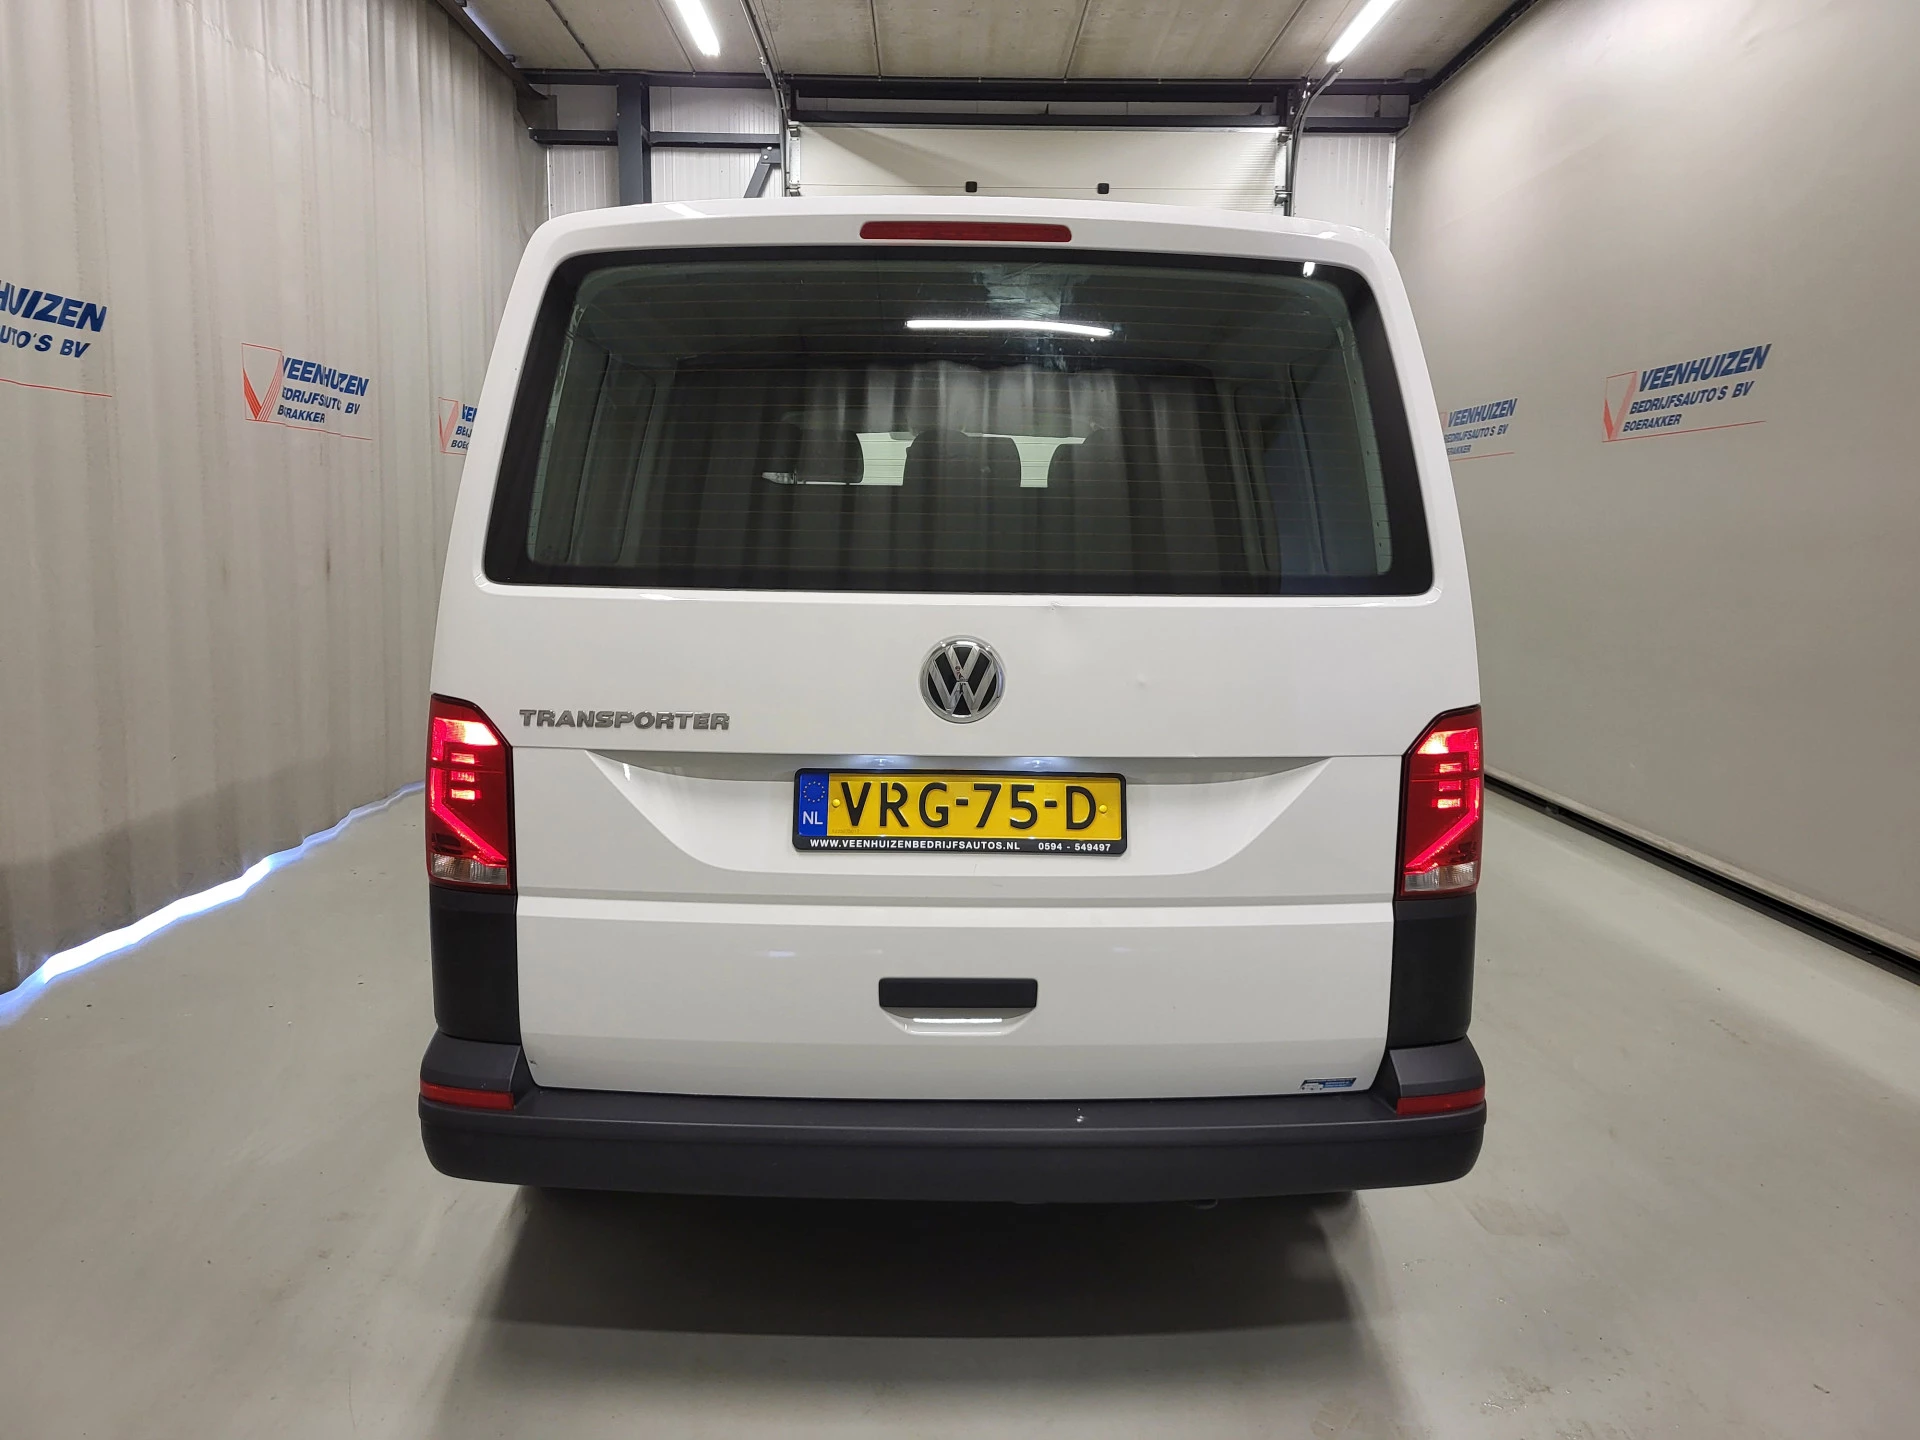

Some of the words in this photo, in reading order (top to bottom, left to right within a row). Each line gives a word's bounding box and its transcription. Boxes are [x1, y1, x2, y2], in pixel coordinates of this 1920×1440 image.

[60, 339, 91, 358] BV
[283, 355, 370, 397] VEENHUZEN
[1639, 343, 1772, 392] VEENHUIZEN
[1629, 386, 1728, 414] BEDRIJFSAUTO'S
[1731, 381, 1755, 398] BV
[345, 402, 361, 415] BV
[1448, 398, 1518, 427] VEENHUIZEN
[1497, 424, 1509, 435] BV
[1623, 414, 1682, 432] BOERAKKER
[519, 709, 730, 730] TRANSPORTER
[841, 781, 1097, 831] VRG-75-D
[802, 811, 824, 826] NL
[810, 839, 1020, 850] WWW.VEENHUIZENBEDRIJFSAUTOS.NL
[1038, 842, 1062, 850] 0594
[1074, 842, 1111, 851] 549497
